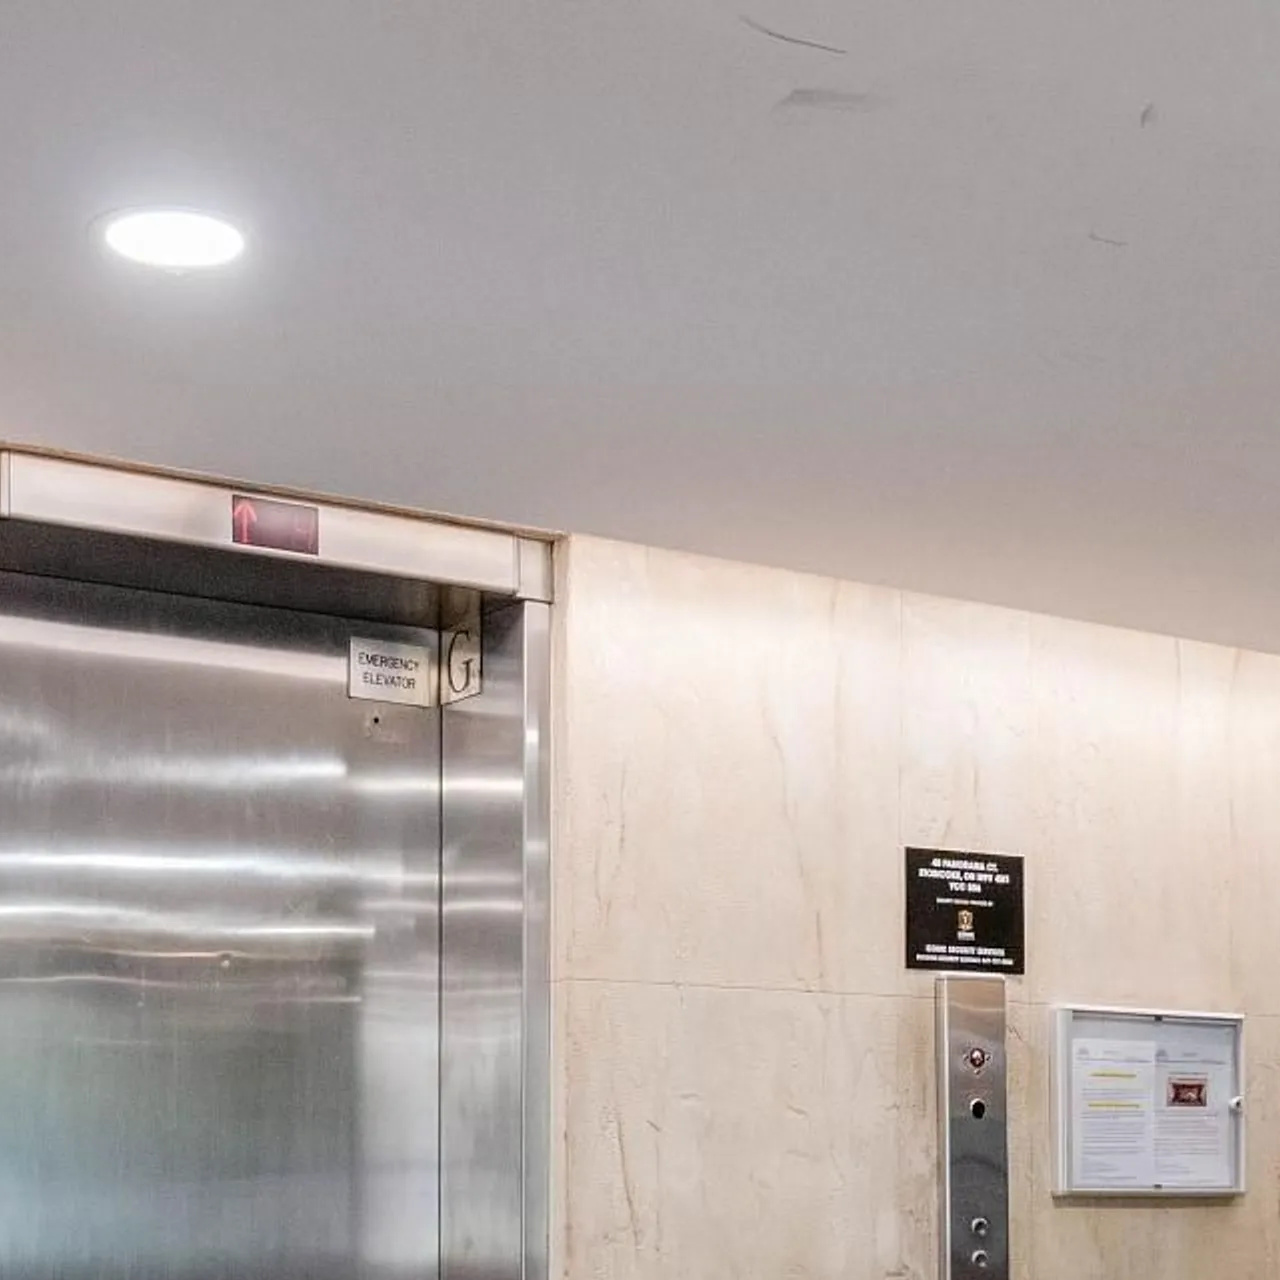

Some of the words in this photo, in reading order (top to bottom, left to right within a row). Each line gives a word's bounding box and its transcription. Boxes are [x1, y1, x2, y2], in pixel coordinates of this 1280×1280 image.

[357, 651, 420, 671] EMERGENCY
[447, 629, 473, 693] G
[362, 671, 417, 689] ELEVATOR
